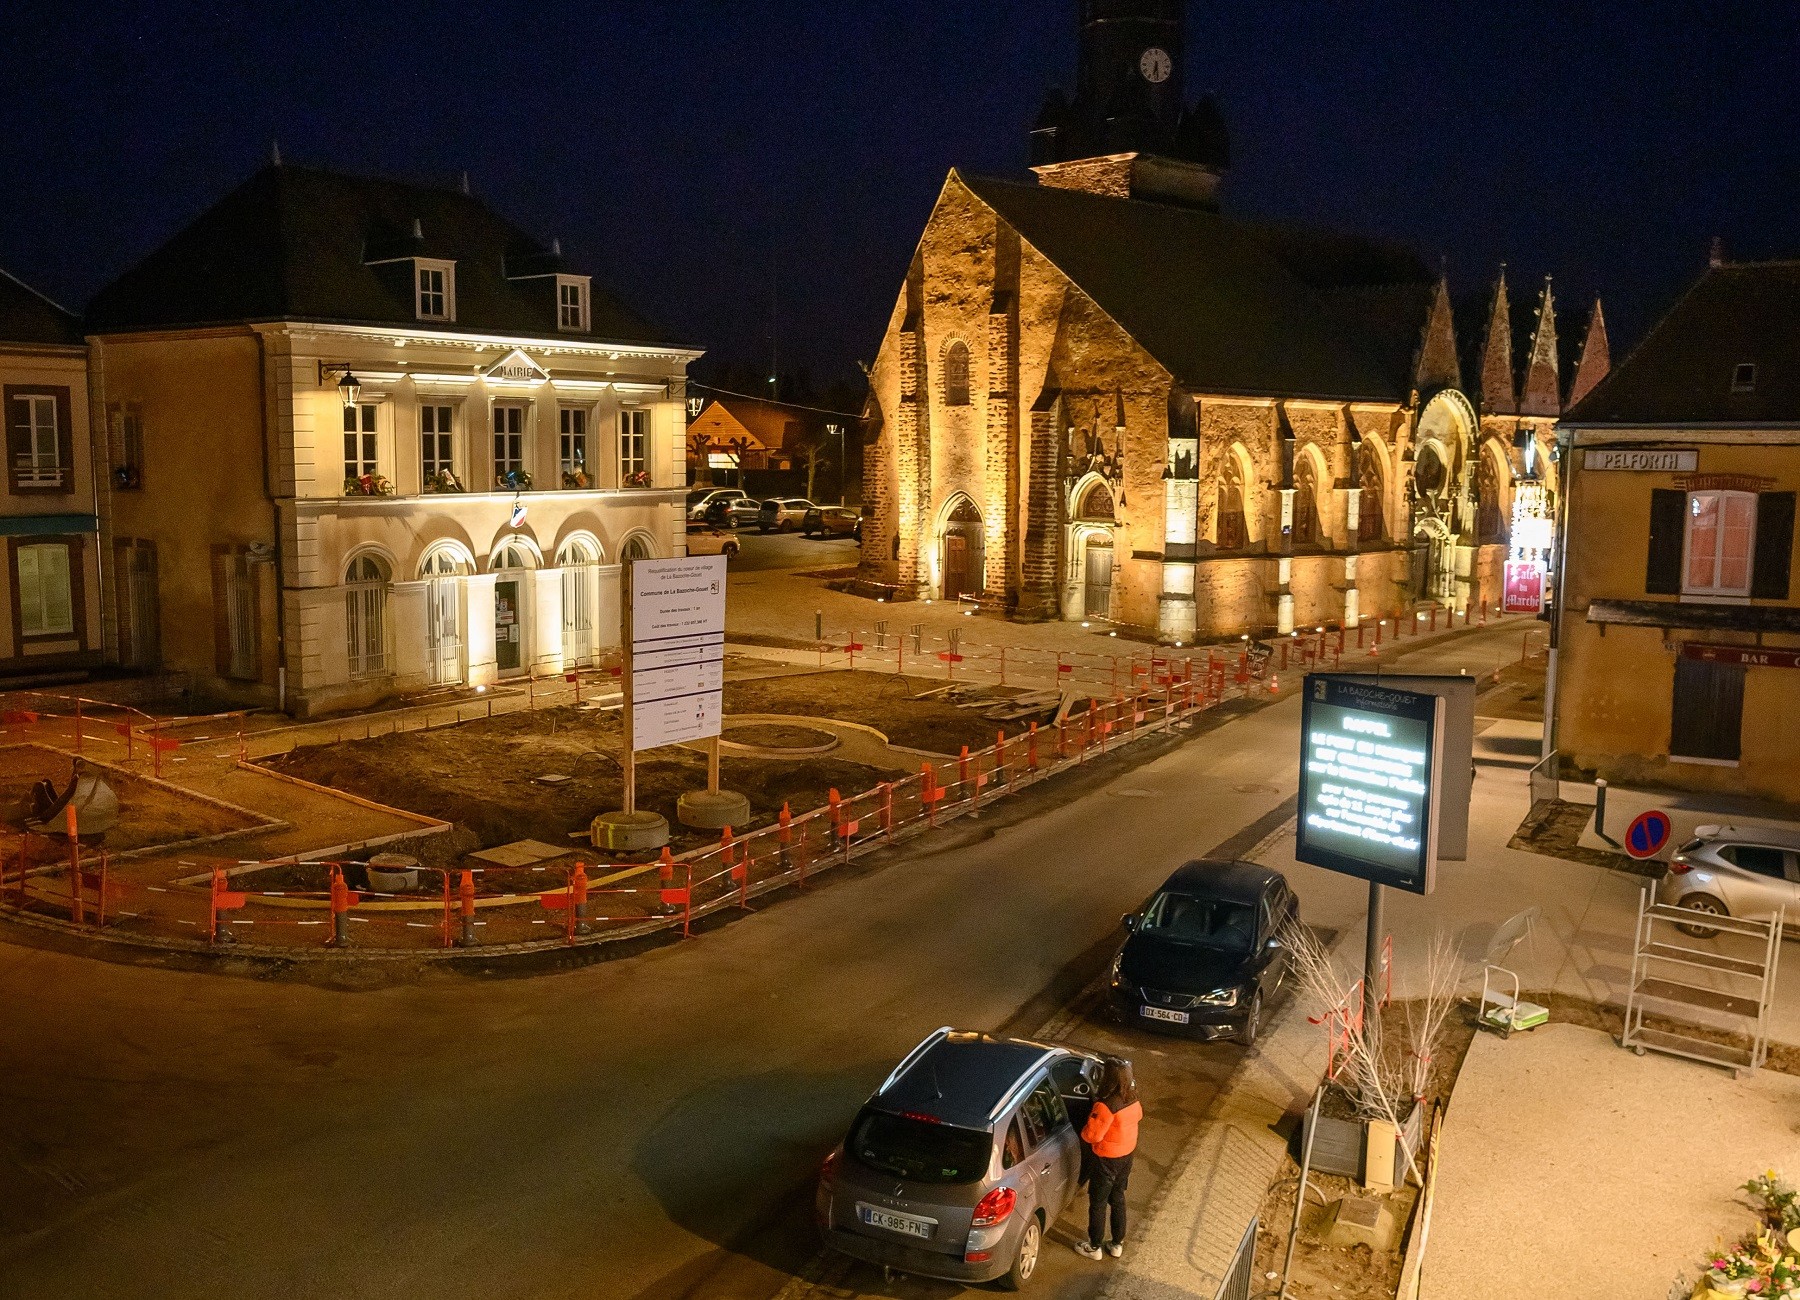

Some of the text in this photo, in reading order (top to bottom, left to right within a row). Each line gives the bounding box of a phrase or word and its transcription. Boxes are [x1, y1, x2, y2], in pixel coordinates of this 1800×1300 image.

[501, 366, 533, 377] MAIRIE
[1604, 453, 1678, 470] PELFORTH
[1506, 594, 1540, 608] Marché
[1741, 653, 1769, 665] BAR
[1338, 685, 1418, 705] LA BAZOCHE-GOUET
[1146, 1007, 1183, 1021] DX-564-CD
[872, 1212, 921, 1234] CK-985-FN
